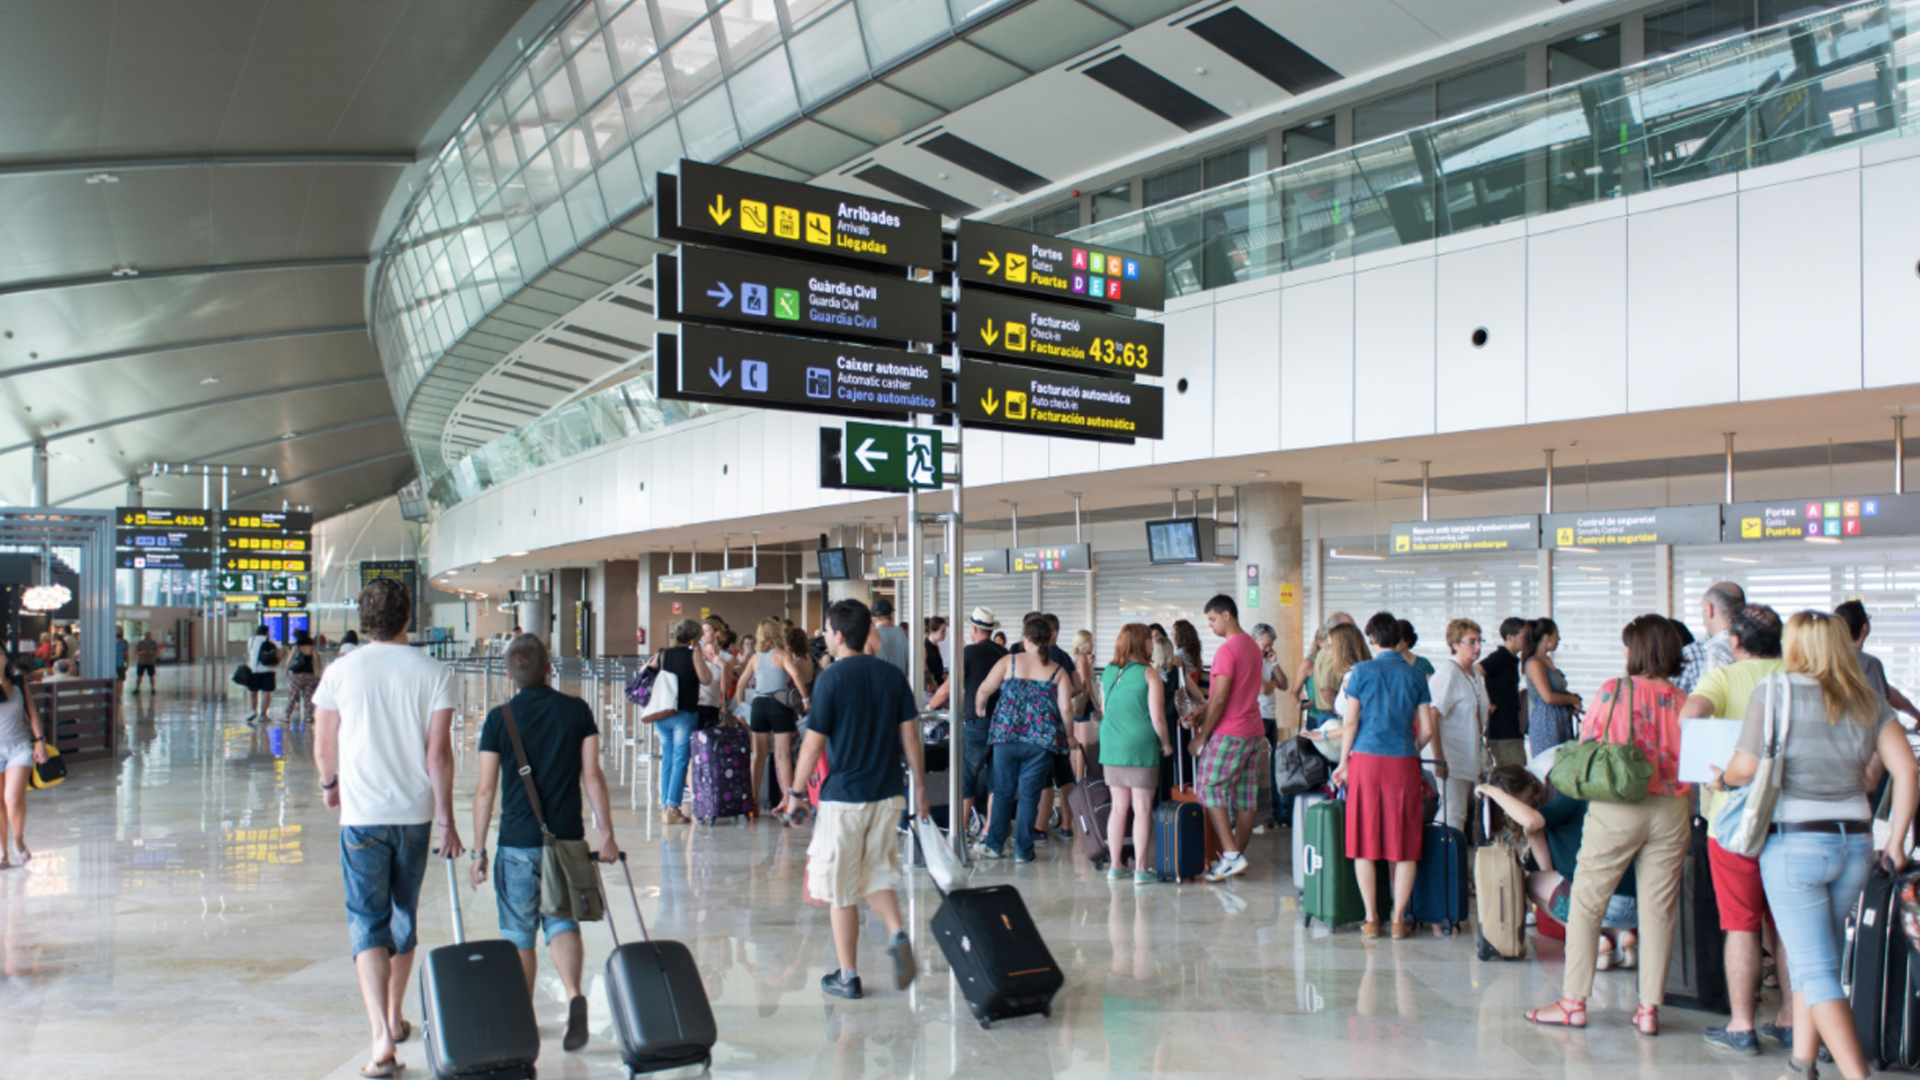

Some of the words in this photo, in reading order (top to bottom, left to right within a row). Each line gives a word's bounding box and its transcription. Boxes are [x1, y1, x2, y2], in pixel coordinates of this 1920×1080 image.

[838, 202, 901, 228] Arribades
[837, 219, 871, 237] Arrivals
[836, 233, 888, 255] Llegadas
[1031, 243, 1064, 262] Portes
[1075, 252, 1084, 267] A
[1092, 256, 1101, 270] B
[1110, 259, 1118, 274] C
[1127, 262, 1136, 277] R
[1031, 259, 1054, 274] Gates
[808, 277, 853, 298] Guàrdia
[853, 283, 877, 301] Civil
[1030, 271, 1068, 290] Puertas
[1074, 277, 1083, 290] D
[1093, 280, 1100, 294] E
[1110, 283, 1118, 297] F
[809, 308, 853, 327] Guardia
[854, 314, 878, 330] Civil
[1030, 312, 1081, 333] Facturació
[1030, 327, 1062, 342] Check-in
[1030, 340, 1086, 360] Facturación
[836, 356, 874, 374] Caixer
[875, 363, 929, 380] automàtic
[837, 371, 881, 388] Automatic
[881, 378, 912, 391] cashier
[837, 386, 875, 404] Cajero
[876, 391, 937, 409] automático
[1030, 380, 1080, 399] Facturació
[1080, 389, 1132, 406] automàtica
[1031, 395, 1049, 408] Auto
[1030, 407, 1086, 426] Facturación
[1086, 416, 1136, 432] automática
[1764, 507, 1797, 518] Portes
[1808, 504, 1818, 516] A
[1828, 504, 1836, 515] B
[1845, 503, 1855, 514] C
[1866, 502, 1875, 513] R
[1576, 516, 1605, 527] Control
[1606, 516, 1616, 526] de
[1601, 525, 1625, 534] Control
[1765, 526, 1802, 537] Puertas
[1808, 522, 1818, 534] D
[1828, 522, 1837, 532] E
[1846, 520, 1855, 532] F
[1577, 534, 1606, 545] Control
[1606, 534, 1616, 543] de
[1617, 532, 1658, 544] seguridad
